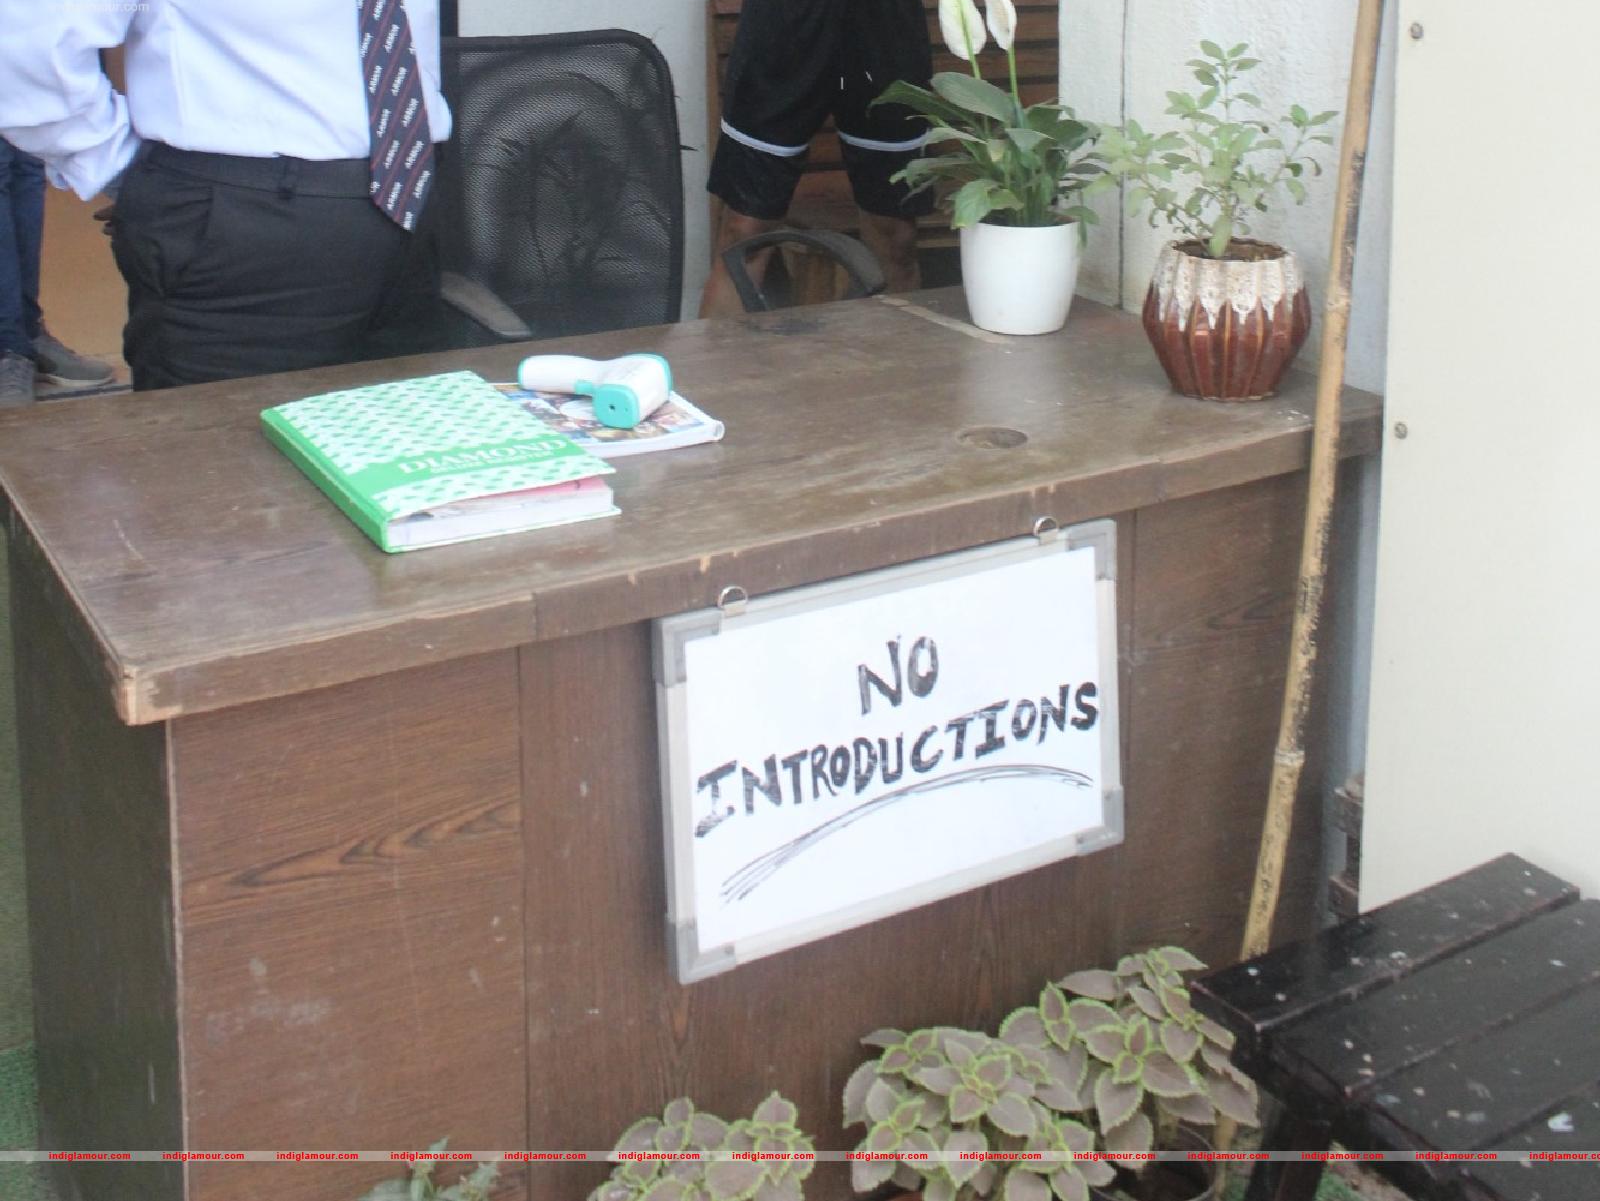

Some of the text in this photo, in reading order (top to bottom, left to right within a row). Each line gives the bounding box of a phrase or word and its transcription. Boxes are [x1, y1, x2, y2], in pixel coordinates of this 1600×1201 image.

[397, 438, 568, 474] DIAMOND
[856, 634, 940, 716] NO
[694, 680, 1099, 838] INTRODUCTIONS
